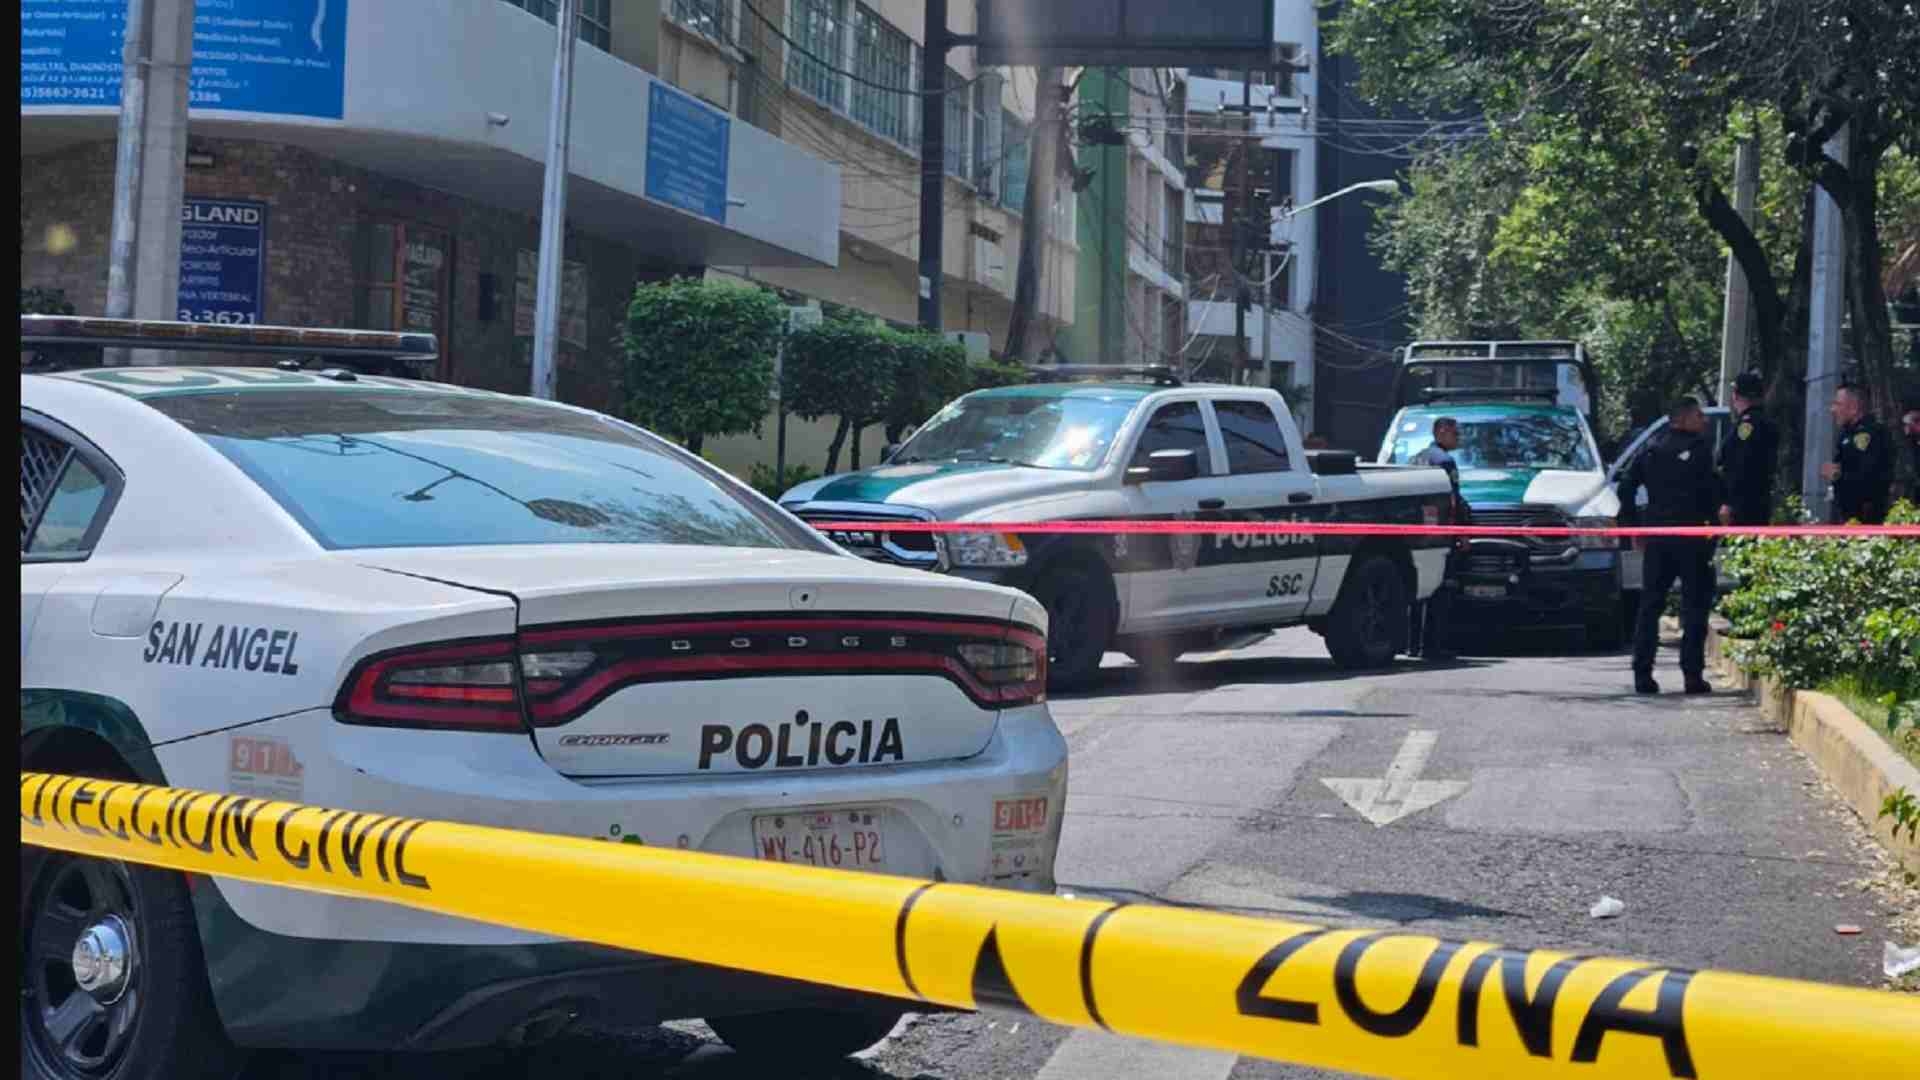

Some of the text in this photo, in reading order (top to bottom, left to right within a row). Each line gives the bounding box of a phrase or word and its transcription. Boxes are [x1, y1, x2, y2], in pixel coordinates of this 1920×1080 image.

[1265, 573, 1303, 597] SSC
[143, 620, 298, 675] SAN ANGEL
[671, 636, 907, 650] DODGE
[276, 806, 431, 890] CIVIL
[1235, 930, 1698, 1079] ZONA
